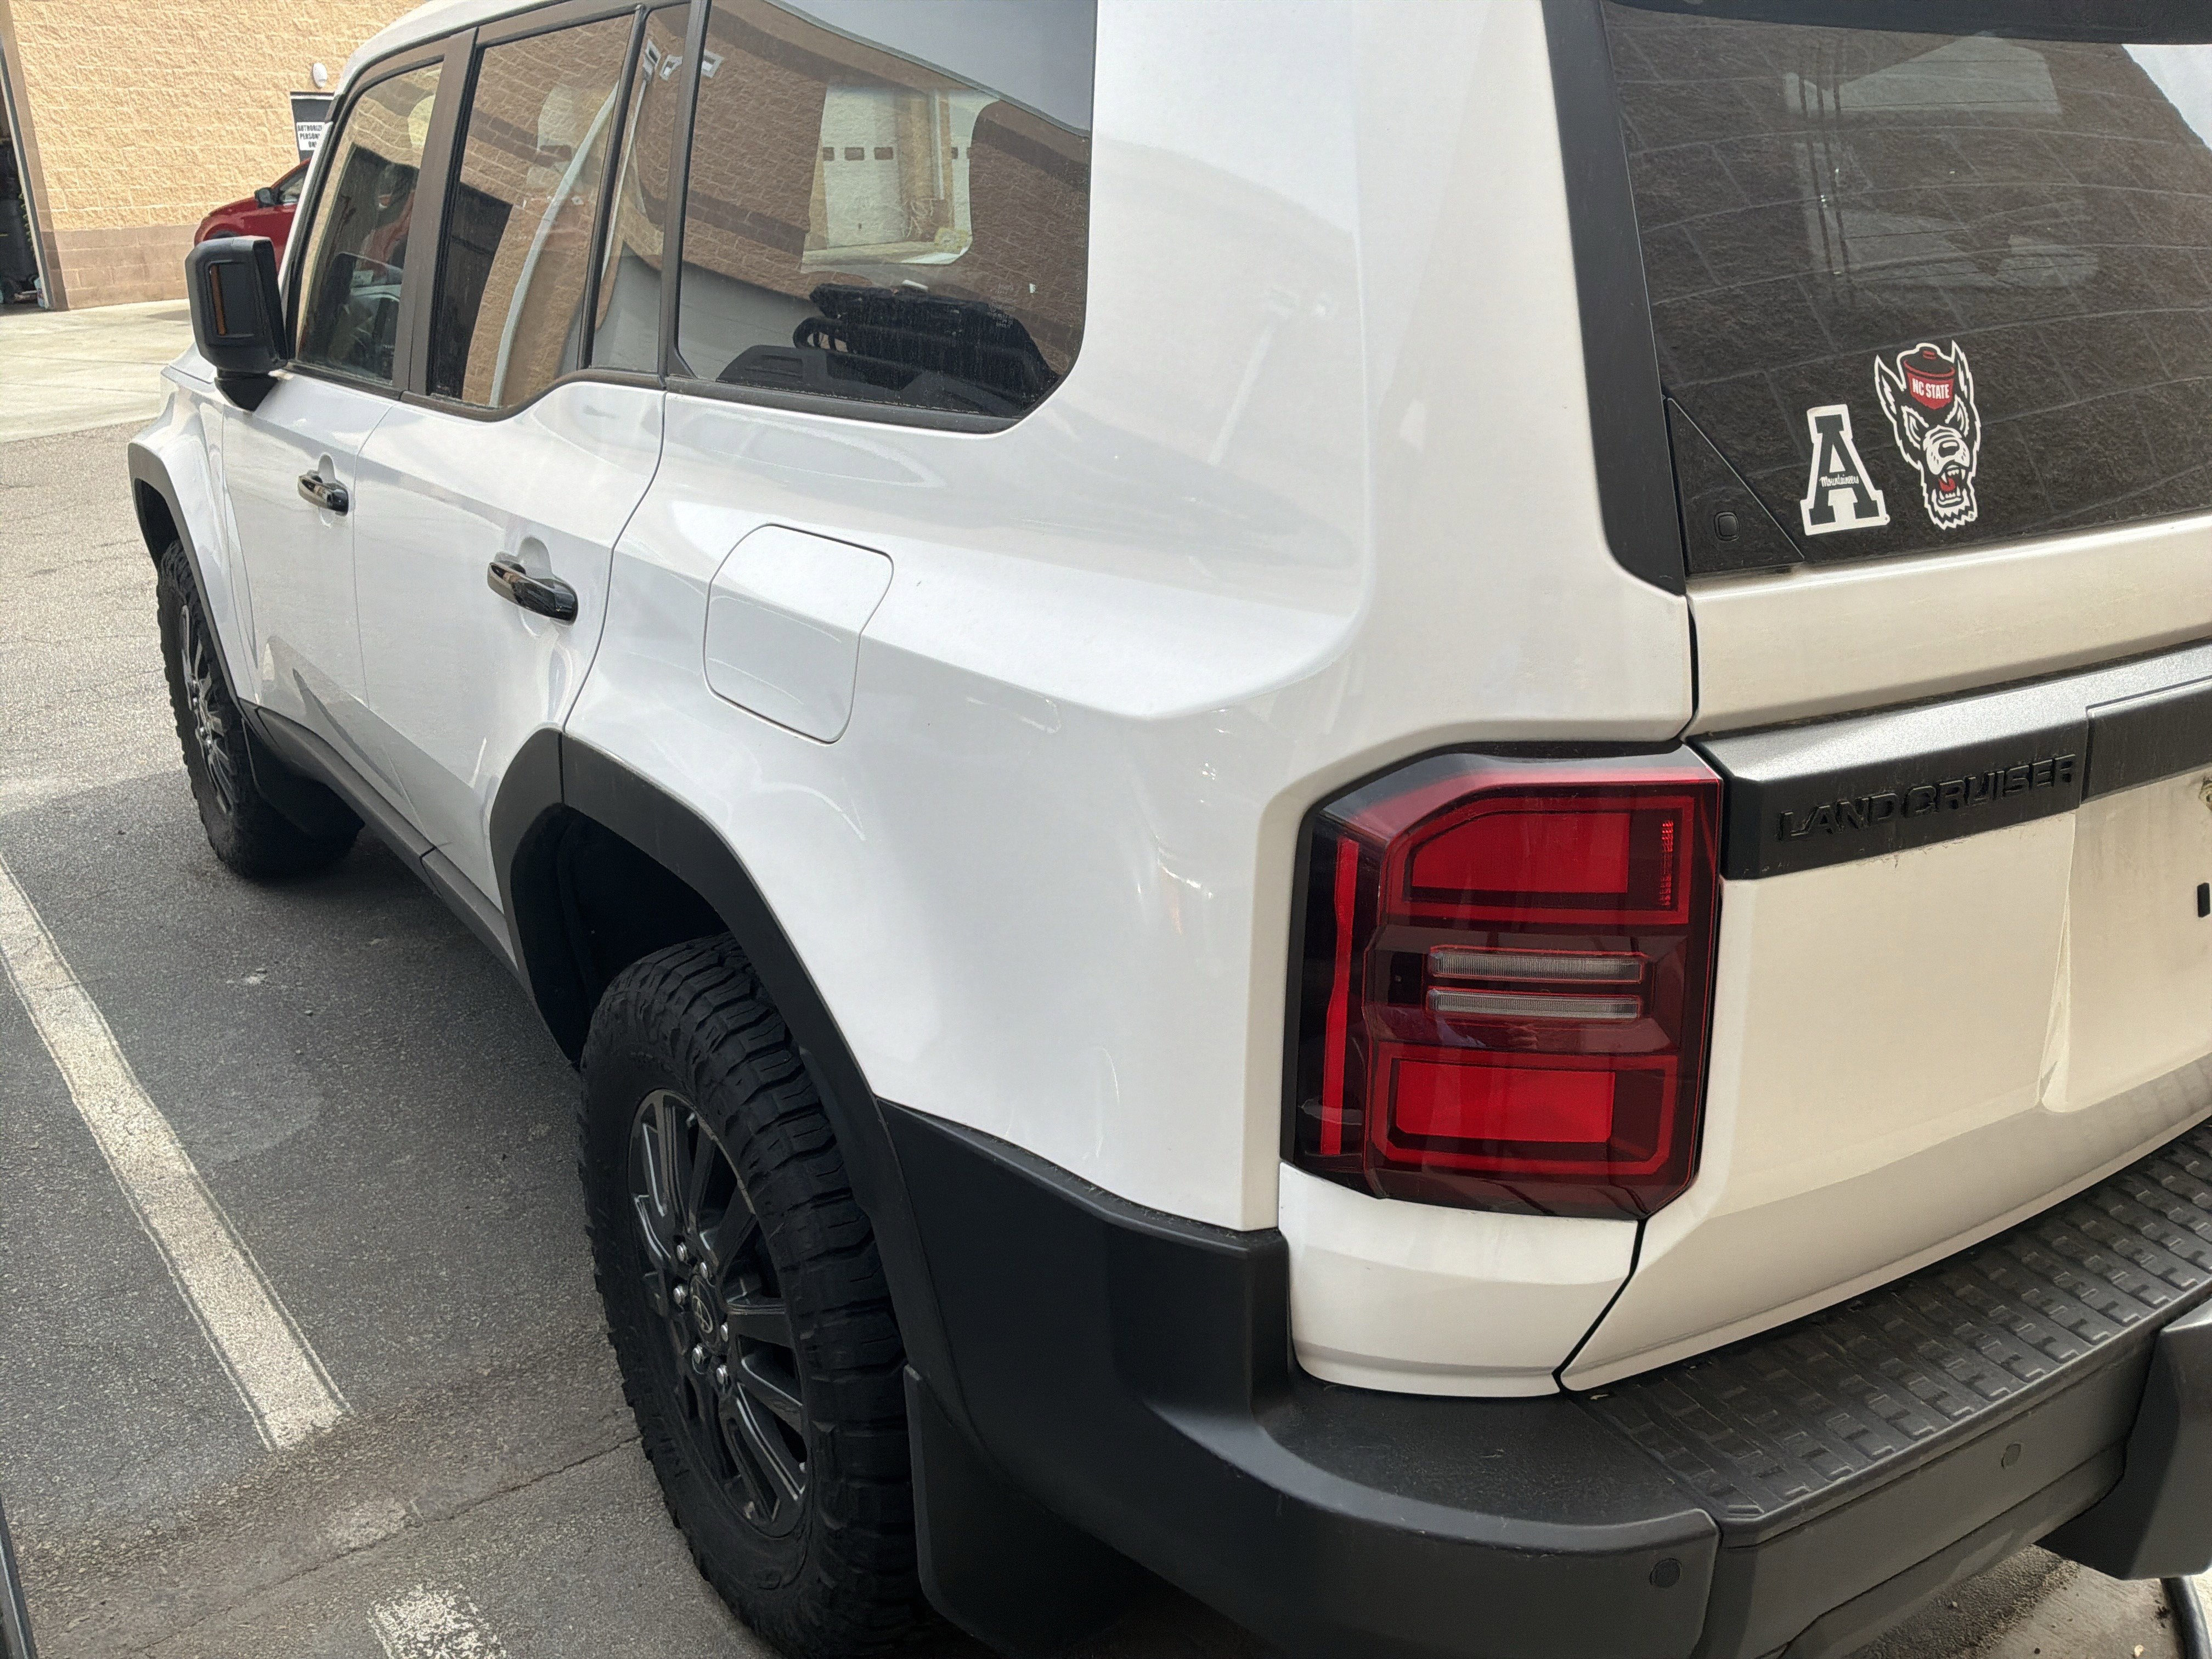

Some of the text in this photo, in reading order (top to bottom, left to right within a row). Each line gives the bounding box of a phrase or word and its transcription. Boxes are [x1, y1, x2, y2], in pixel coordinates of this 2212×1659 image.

[1912, 378, 1950, 399] NC STATE
[1805, 409, 1884, 531] A
[1819, 473, 1859, 487] Mountaineers
[1778, 753, 2076, 841] LAND CRUISER
